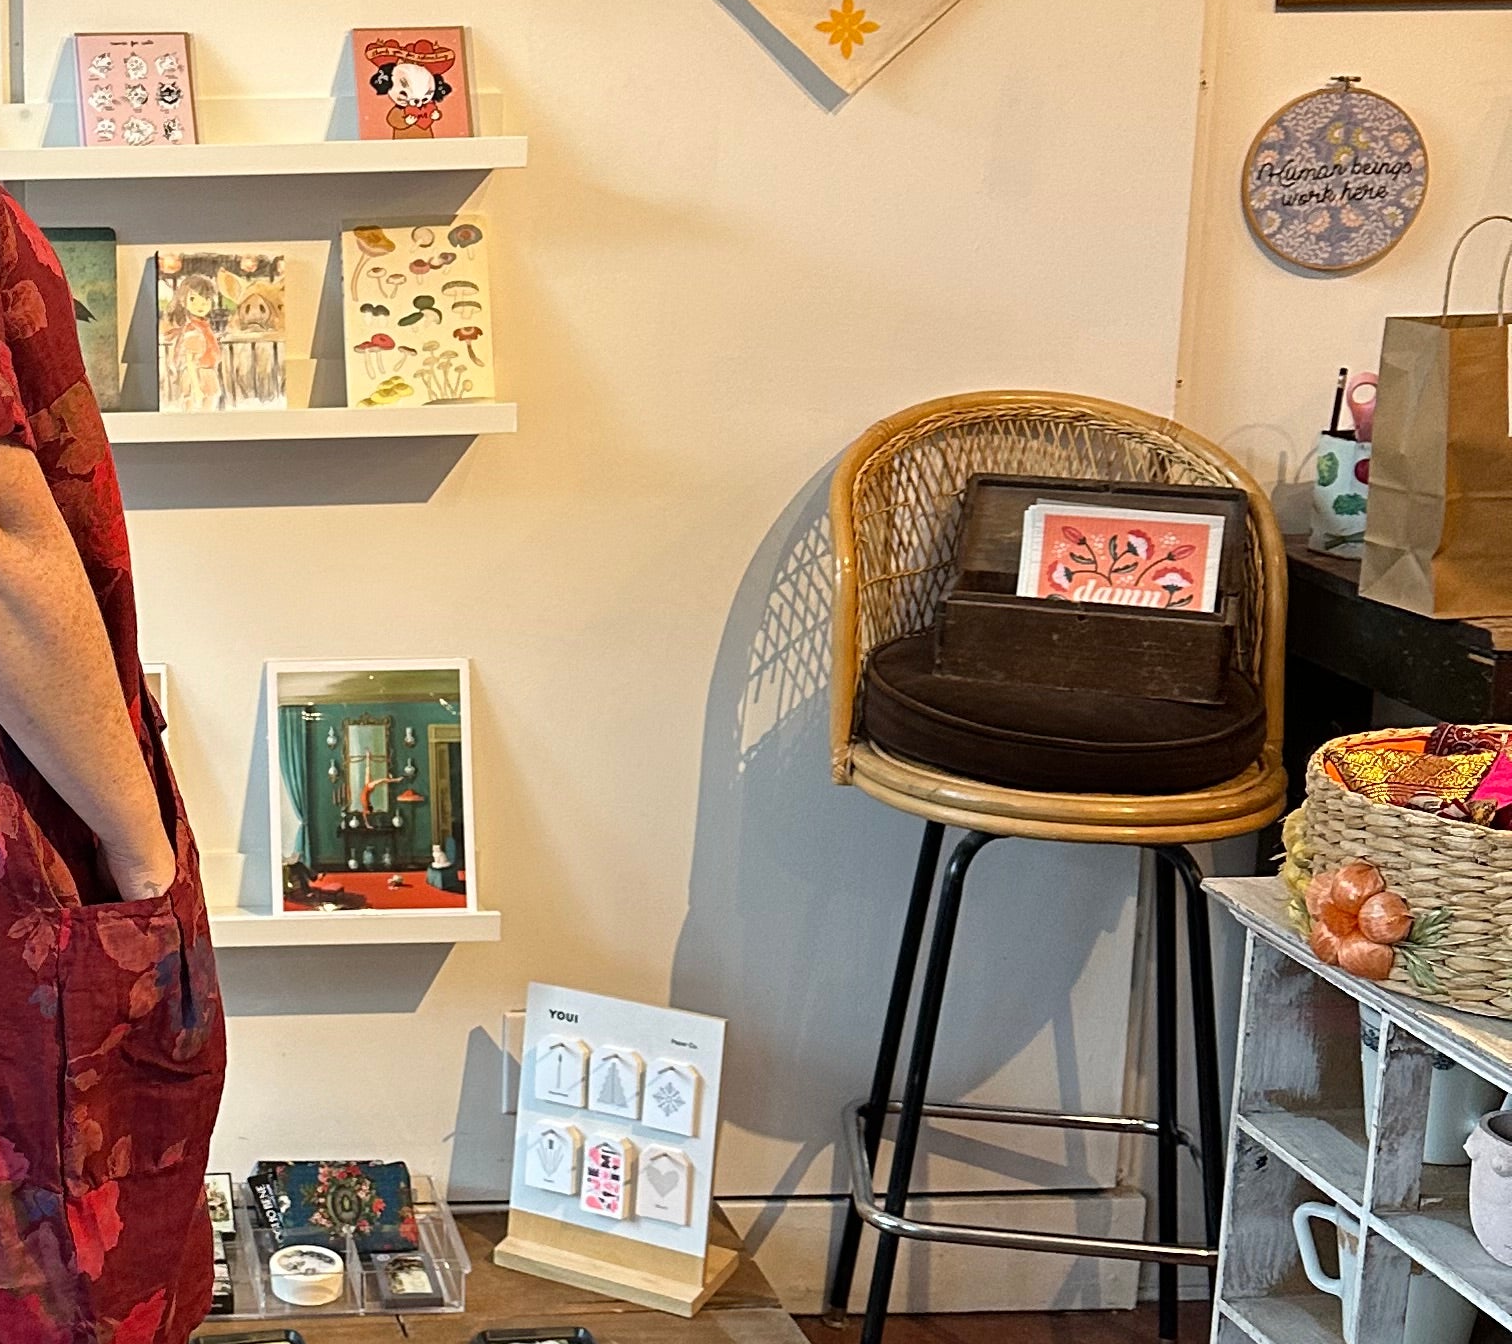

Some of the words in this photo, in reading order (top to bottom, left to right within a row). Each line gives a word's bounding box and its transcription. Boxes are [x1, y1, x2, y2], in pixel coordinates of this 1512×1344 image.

[1350, 156, 1413, 182] beings
[1281, 182, 1337, 207] work
[1339, 180, 1390, 203] here
[1072, 578, 1162, 608] damn
[549, 1009, 579, 1024] YOUI
